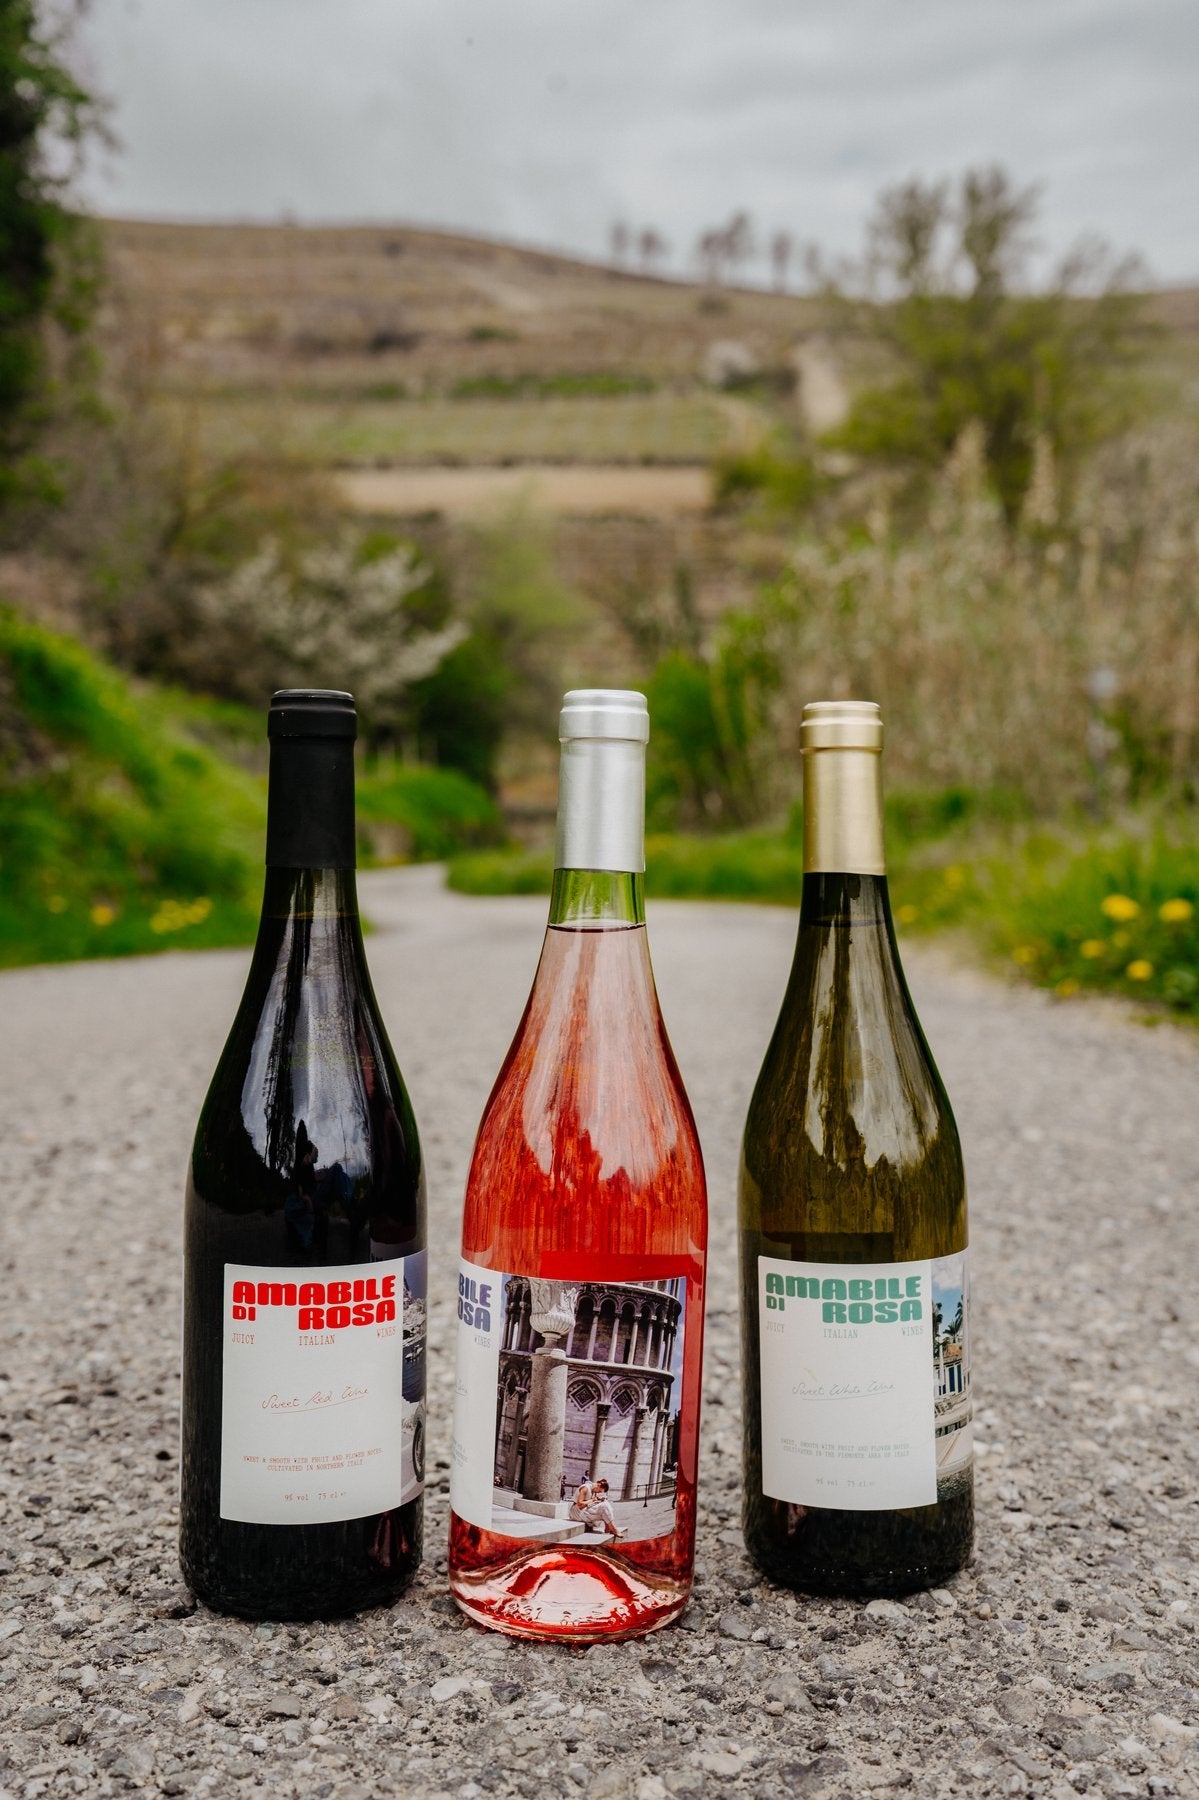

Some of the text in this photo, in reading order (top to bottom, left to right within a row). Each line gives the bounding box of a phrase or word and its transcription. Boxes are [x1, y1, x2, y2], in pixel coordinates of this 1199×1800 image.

[233, 1275, 396, 1306] AMABILE
[766, 1273, 921, 1300] AMABILE
[232, 1300, 396, 1330] DI ROSA
[766, 1296, 922, 1324] DI ROSA
[232, 1326, 396, 1346] JUICY ITALIAN WINES
[766, 1321, 924, 1339] JUICY ITALIAN WINES
